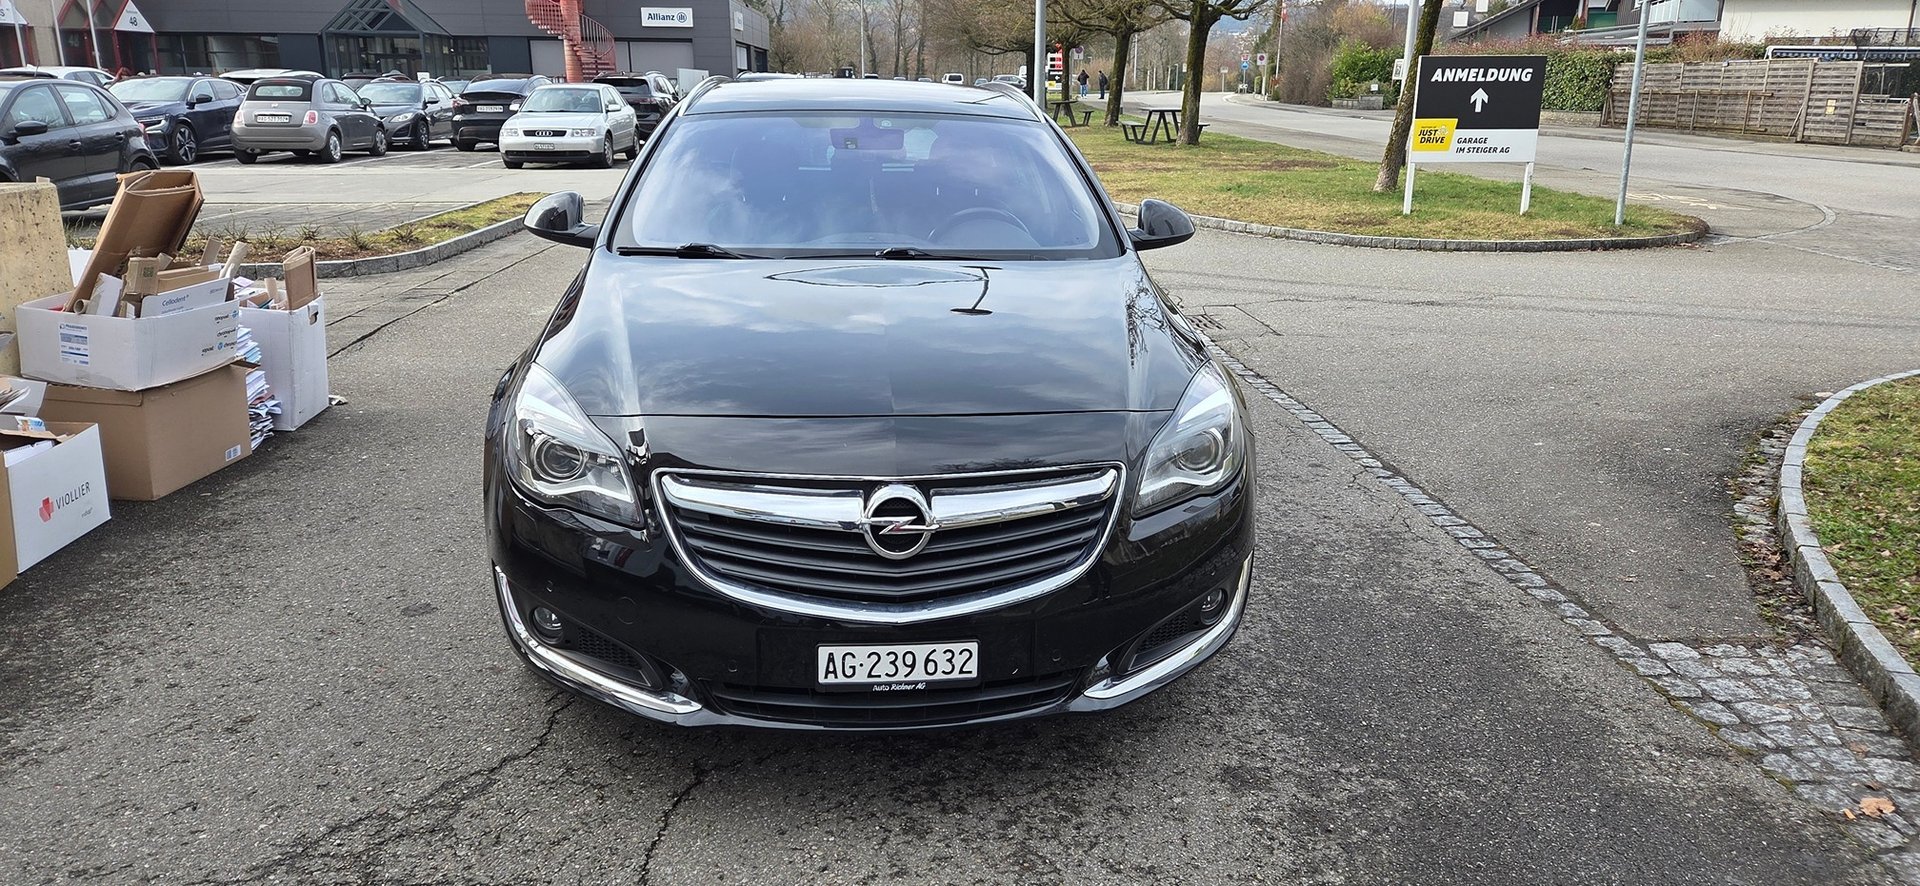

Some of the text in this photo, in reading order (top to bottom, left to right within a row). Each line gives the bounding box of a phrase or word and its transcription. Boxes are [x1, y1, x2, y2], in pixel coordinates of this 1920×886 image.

[129, 16, 138, 26] 48
[647, 13, 675, 21] Allianz
[1430, 68, 1534, 82] ANMELDUNG
[1418, 129, 1438, 137] JUST
[1420, 136, 1445, 144] DRIVE
[56, 481, 91, 510] VIOLLIER
[923, 648, 973, 677] 632
[915, 682, 926, 690] AG
